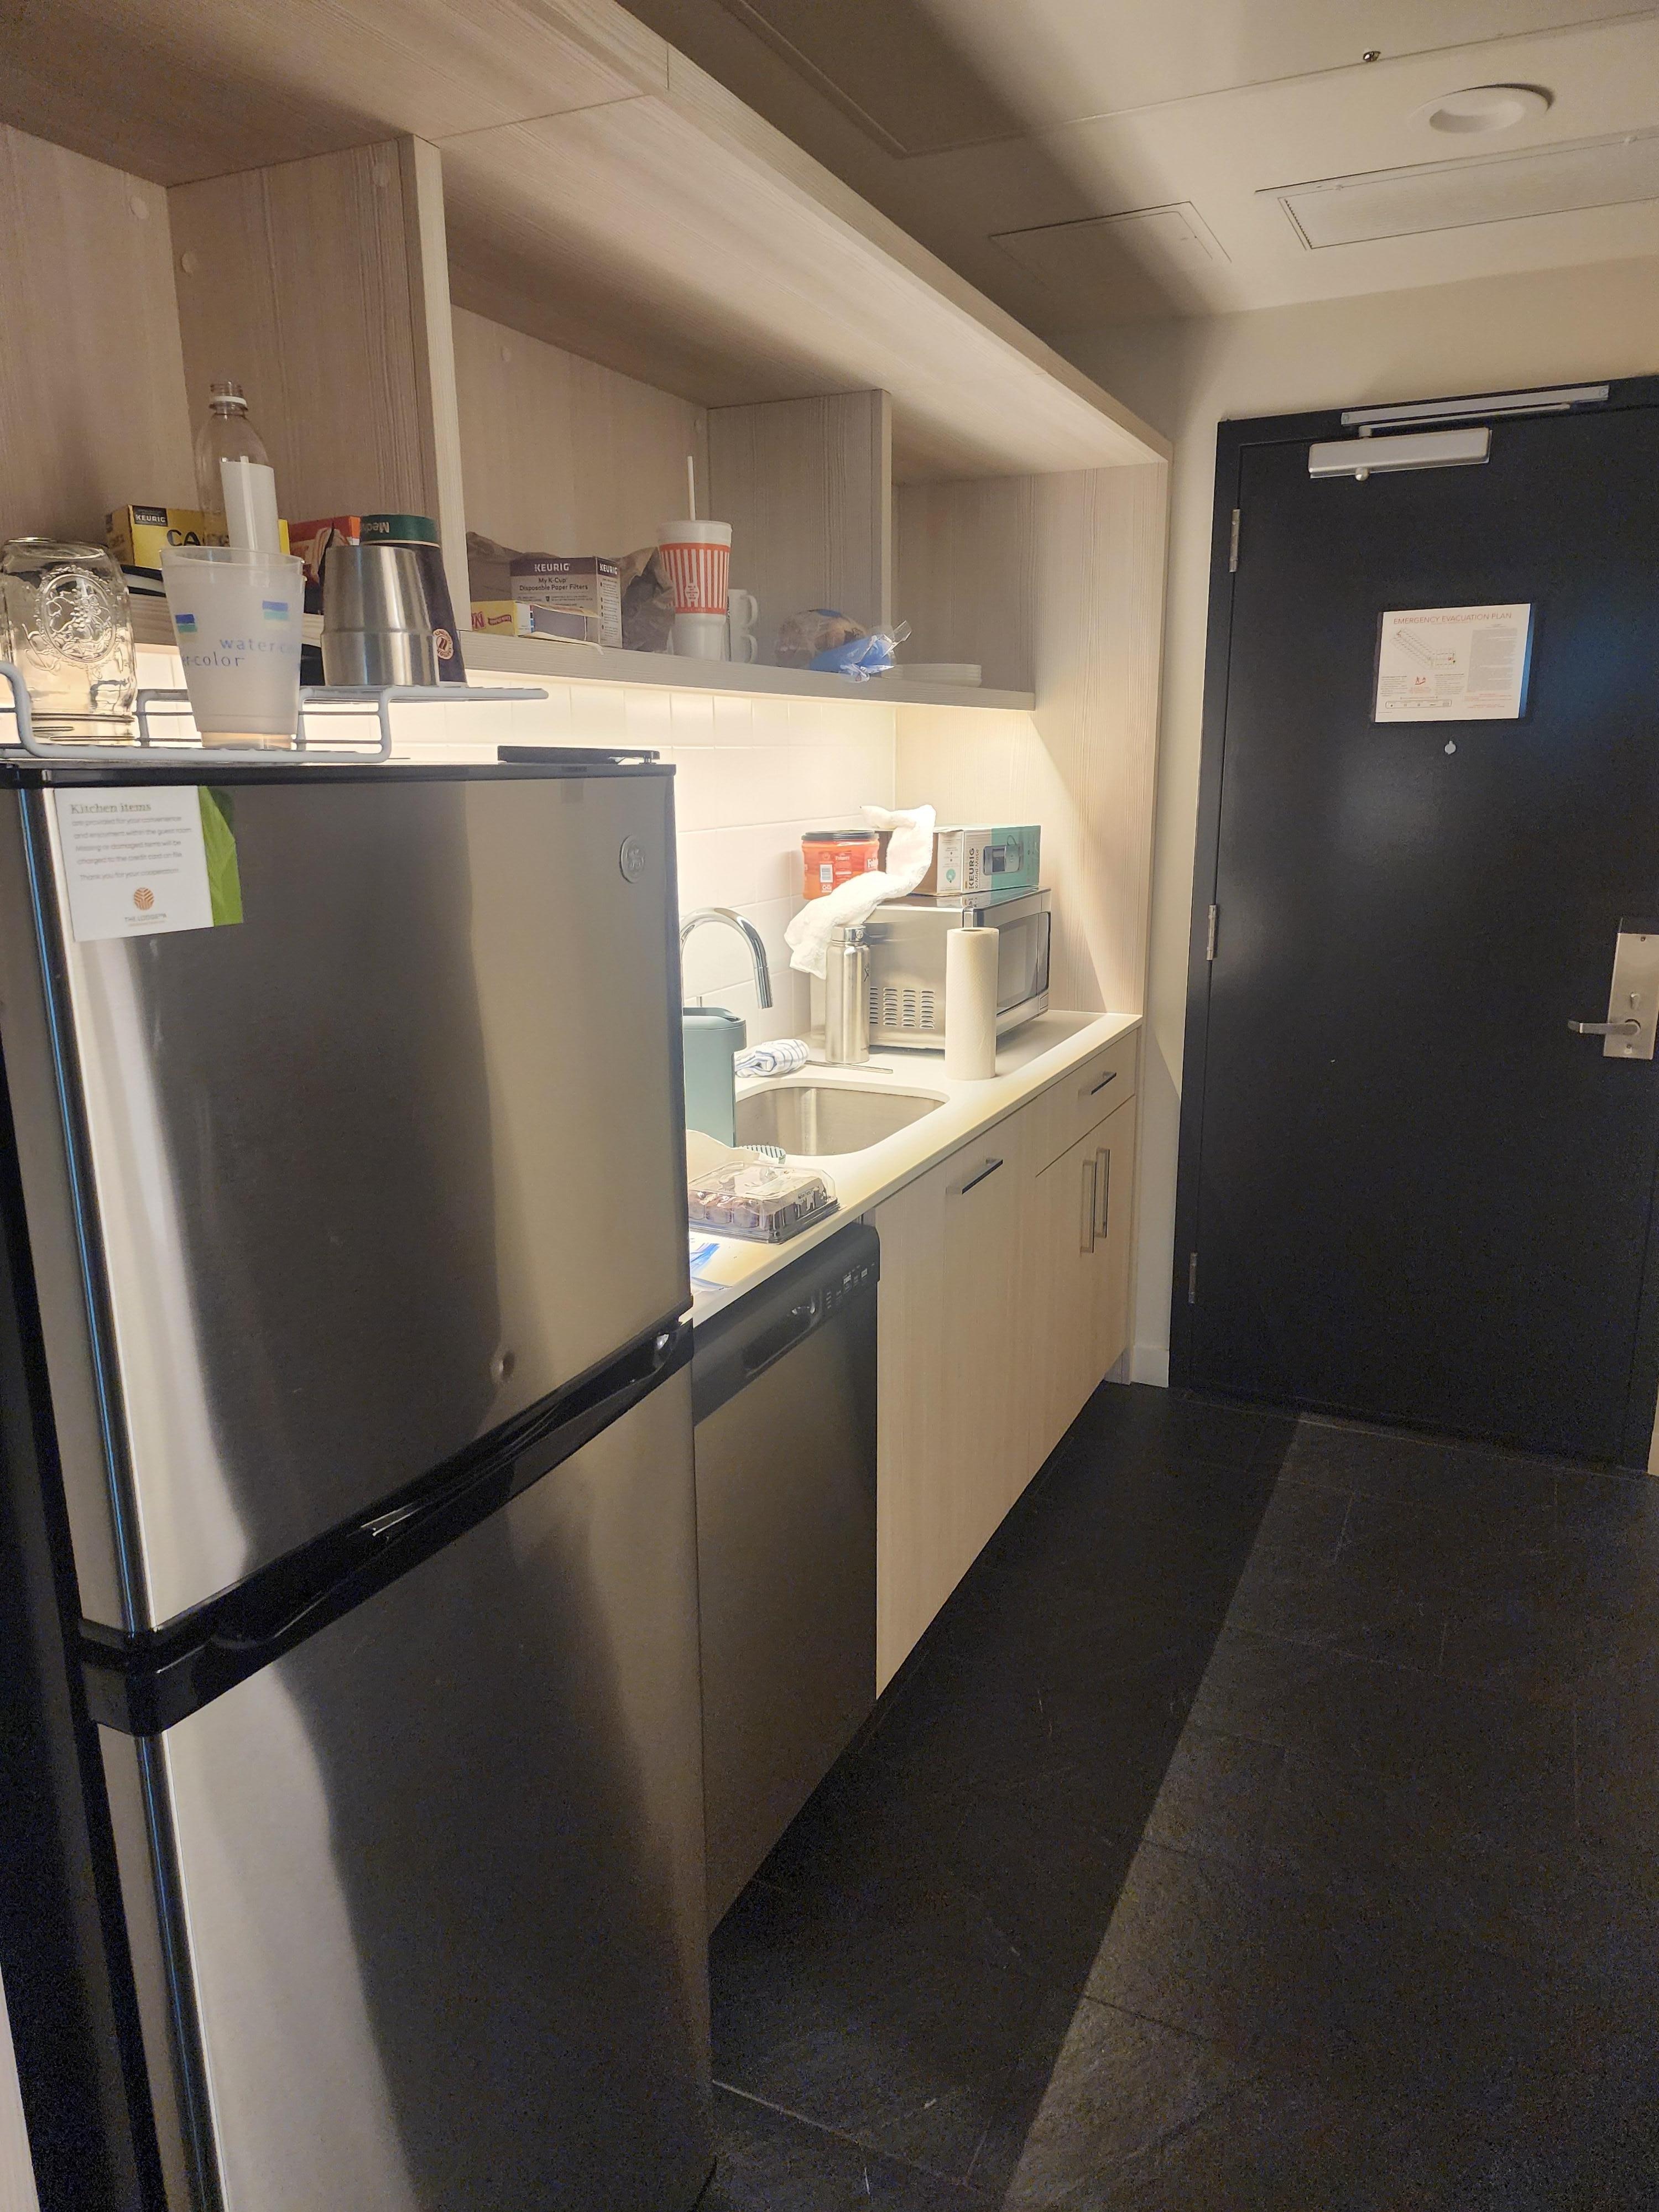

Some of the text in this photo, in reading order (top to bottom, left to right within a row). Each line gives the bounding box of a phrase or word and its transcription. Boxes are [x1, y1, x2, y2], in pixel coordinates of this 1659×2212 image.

[135, 514, 166, 524] KEURIG
[534, 562, 570, 572] KEURIG
[599, 563, 618, 575] KEURIG
[1394, 616, 1440, 624] EMERGENCY
[1442, 614, 1489, 622] EVACUATION
[71, 803, 151, 815] Kitchen items
